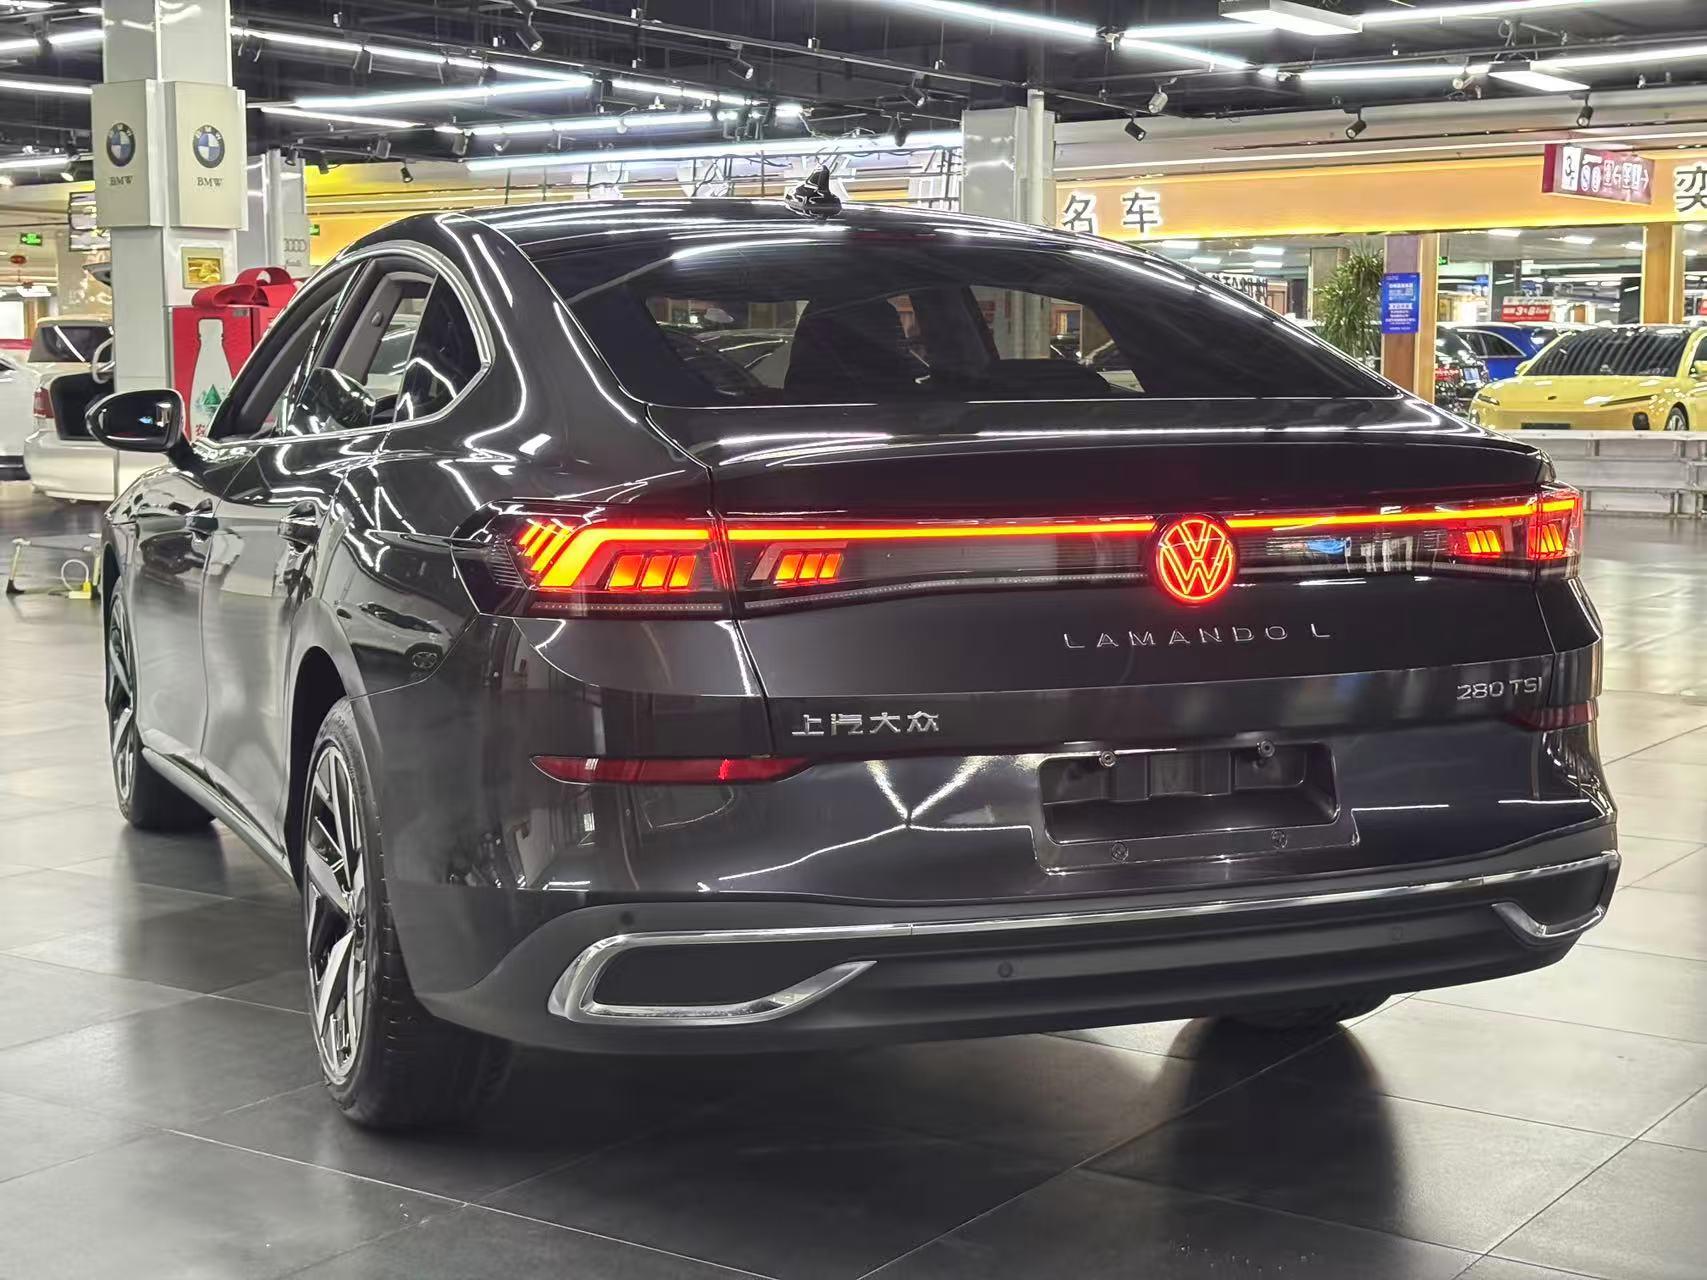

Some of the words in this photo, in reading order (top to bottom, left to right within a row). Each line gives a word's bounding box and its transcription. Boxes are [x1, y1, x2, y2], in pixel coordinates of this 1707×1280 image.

[109, 175, 133, 187] BMW
[197, 176, 223, 187] BMW
[1060, 191, 1159, 234] 名车
[1063, 625, 1289, 649] LAMANDO
[1311, 623, 1331, 638] L
[1456, 680, 1505, 701] 280
[1509, 676, 1543, 696] TSI
[791, 710, 940, 737] 上汽大众
